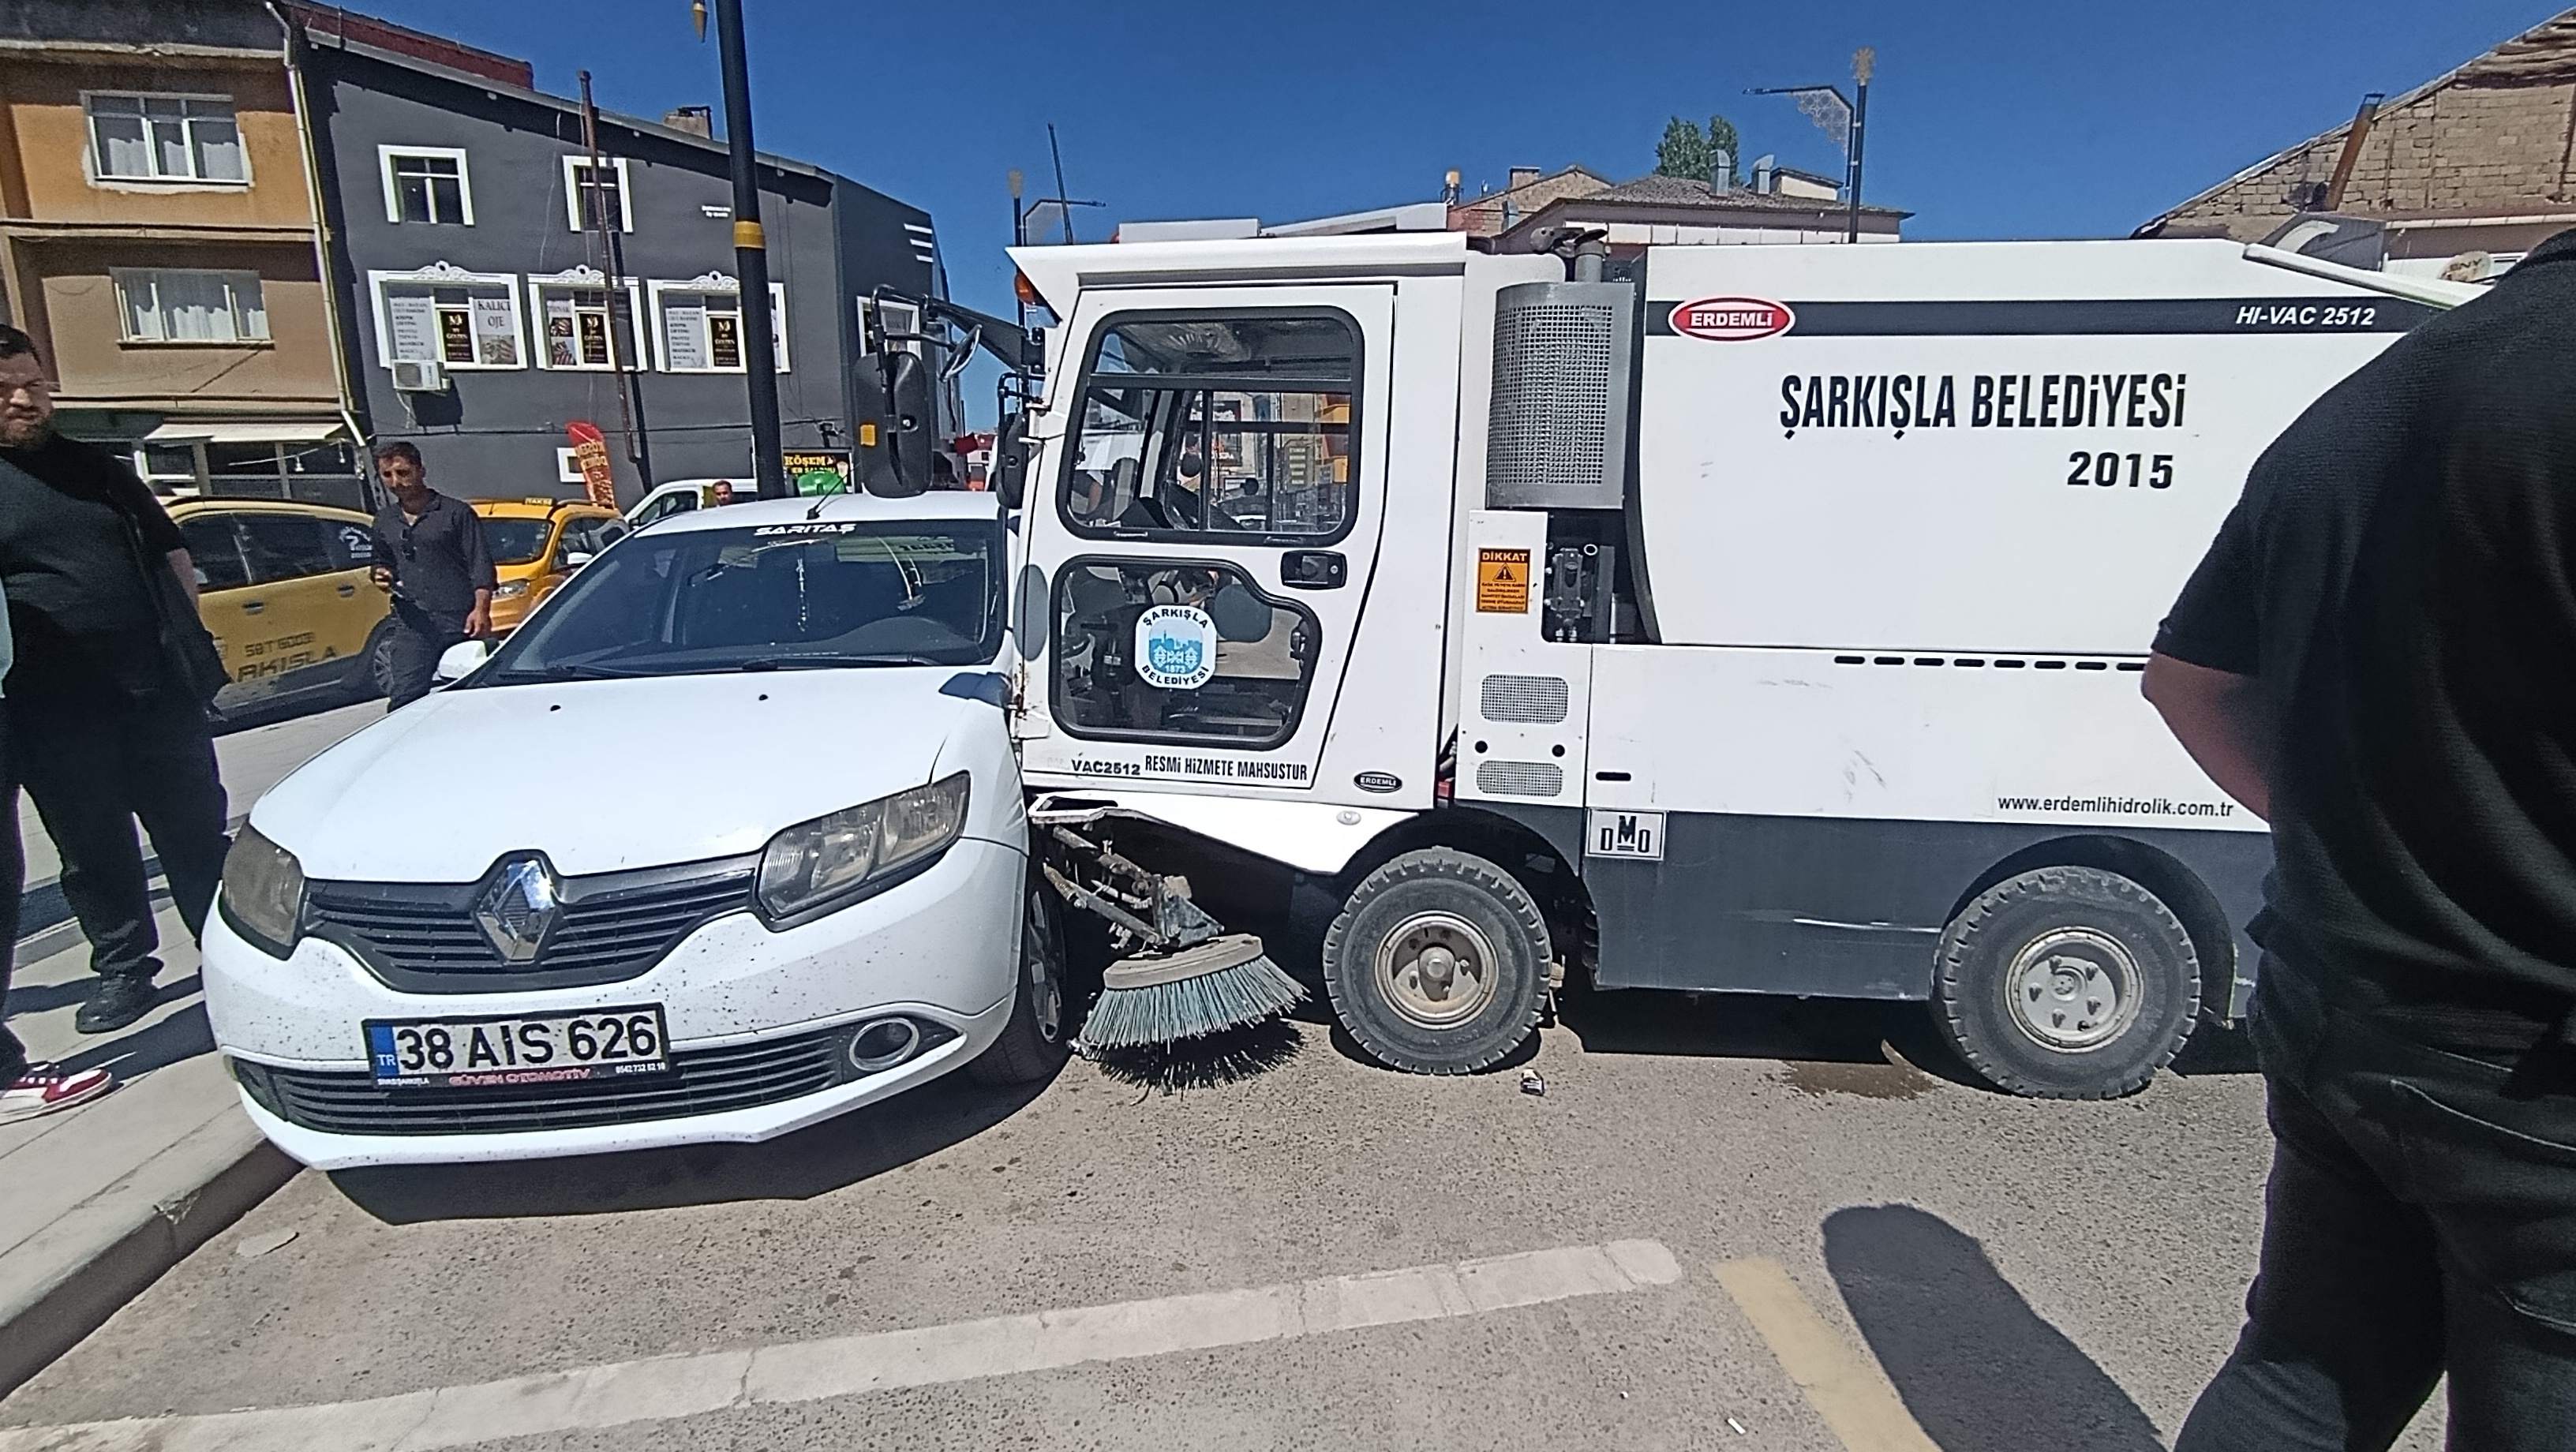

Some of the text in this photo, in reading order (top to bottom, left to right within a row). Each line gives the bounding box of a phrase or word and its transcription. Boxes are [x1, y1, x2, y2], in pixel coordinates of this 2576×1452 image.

[2235, 306, 2376, 325] HI-VAC 2512
[1780, 374, 1956, 440] ŞARKIŞLA
[2067, 451, 2174, 489] 2015
[753, 523, 857, 536] SARITAŞ
[1481, 551, 1528, 562] DİKKAT
[1143, 608, 1208, 628] ŞARKIŞLA
[1071, 759, 1141, 776] VAC2512
[1237, 761, 1308, 780] MAHSUSTUR
[1998, 795, 2234, 818] www.erdemlihidrolik.com.tr
[396, 1014, 657, 1071] 38 AIS 626
[377, 1054, 396, 1065] TR
[449, 1074, 504, 1087] GÜVEN
